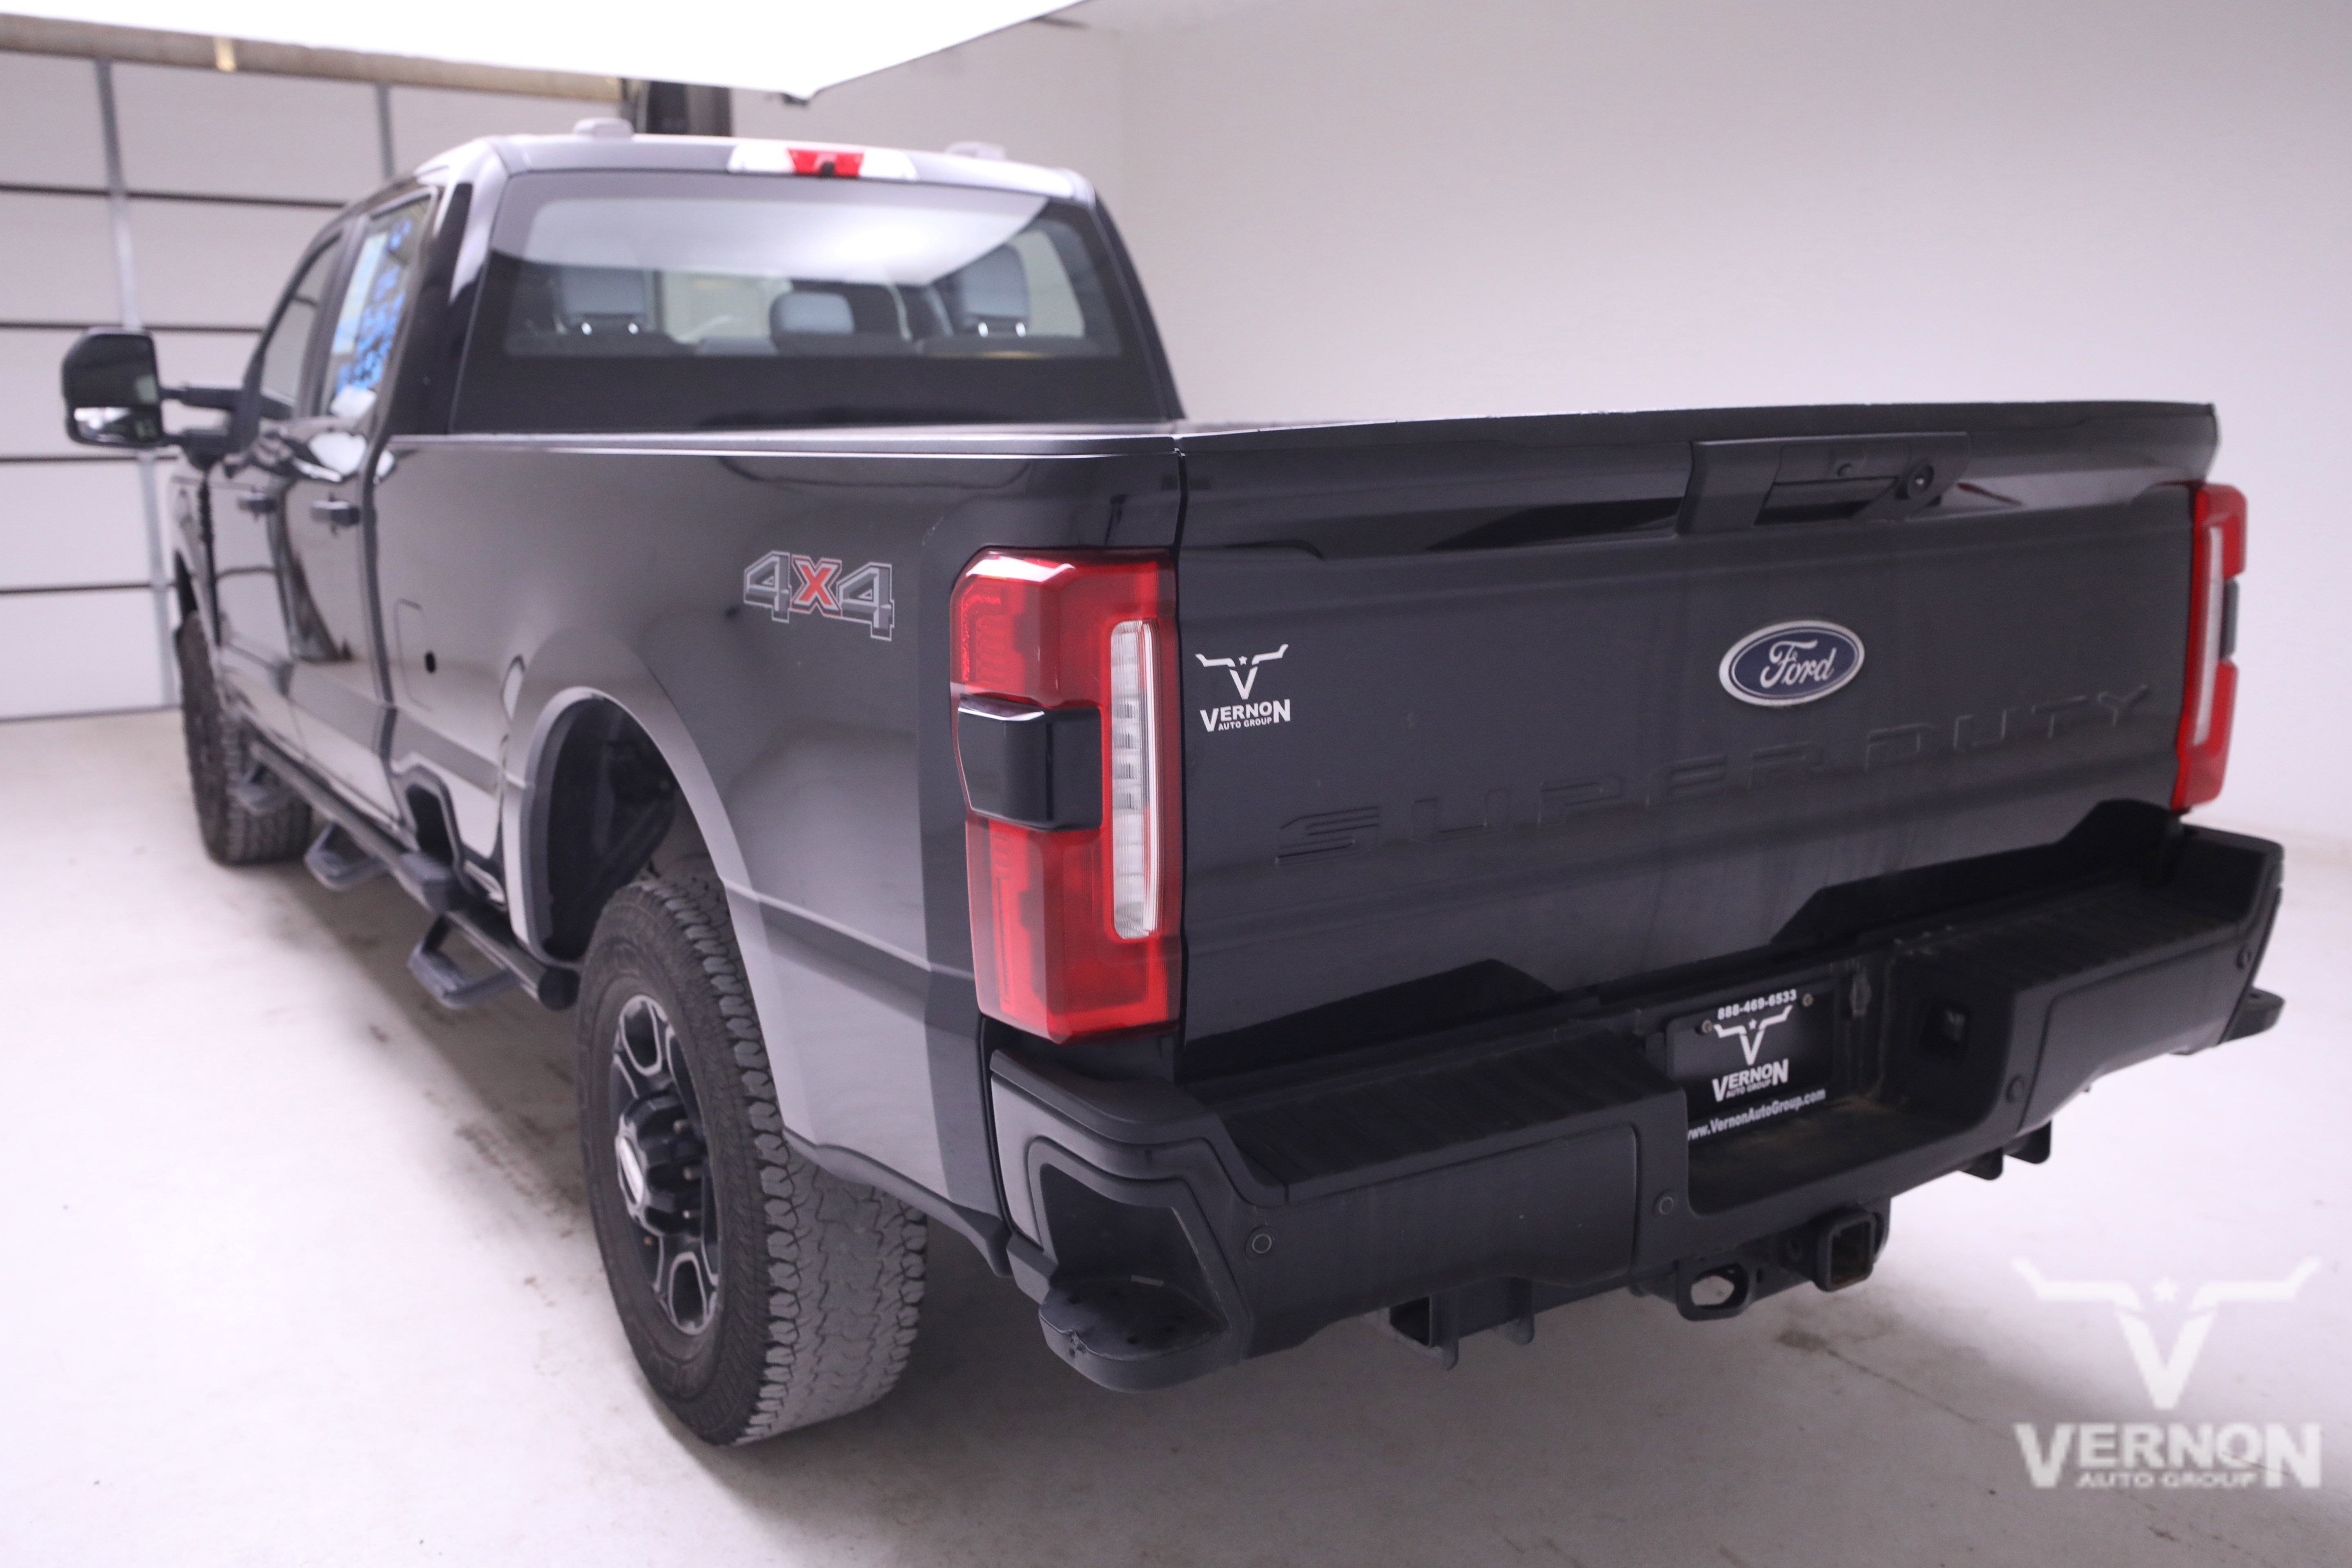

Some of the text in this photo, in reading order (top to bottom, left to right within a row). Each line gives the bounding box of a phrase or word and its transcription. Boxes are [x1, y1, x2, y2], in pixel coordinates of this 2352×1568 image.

[1760, 639, 1837, 688] Ford
[1200, 699, 1291, 732] VERNON
[1218, 717, 1272, 731] AUTO GROUP
[1273, 683, 2149, 867] SUPER DUTY
[1712, 1058, 1789, 1102] VERNON
[1725, 1086, 1746, 1098] AUTO
